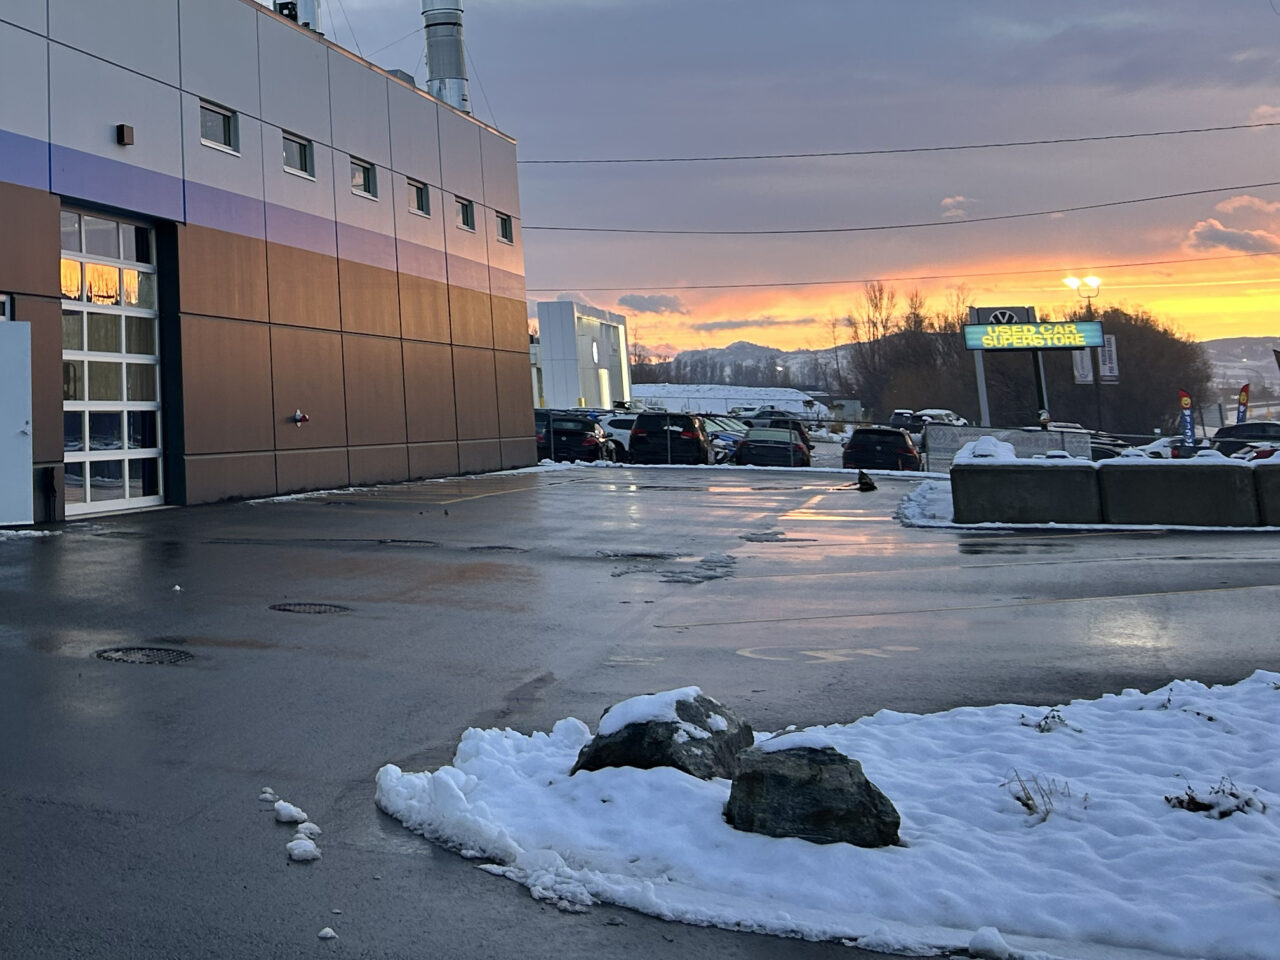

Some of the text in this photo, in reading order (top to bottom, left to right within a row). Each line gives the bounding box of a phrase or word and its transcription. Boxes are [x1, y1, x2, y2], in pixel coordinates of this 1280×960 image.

[987, 323, 1077, 337] USED CAR
[982, 333, 1086, 348] SUPERSTORE
